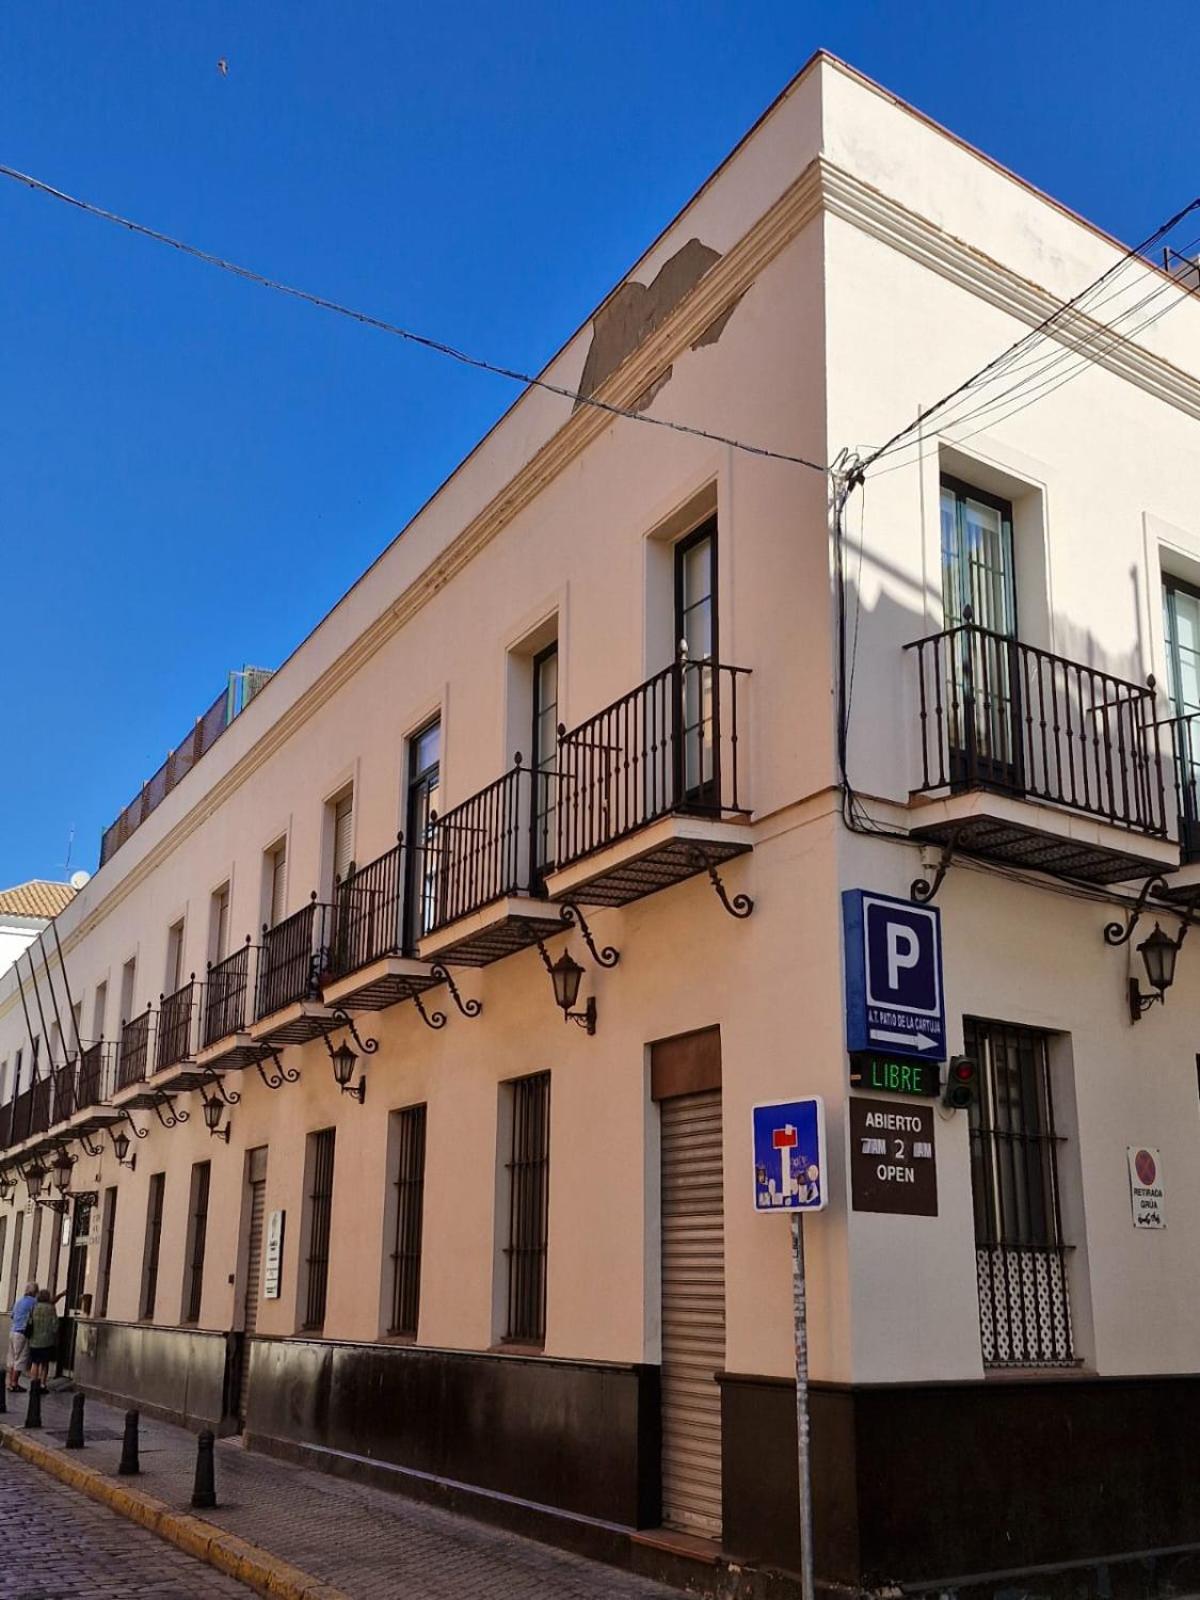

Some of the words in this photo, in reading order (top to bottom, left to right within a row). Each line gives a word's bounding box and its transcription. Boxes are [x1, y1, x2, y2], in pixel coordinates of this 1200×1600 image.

[886, 921, 920, 990] P
[880, 1011, 897, 1027] PATIO
[897, 1014, 906, 1028] DE
[906, 1016, 914, 1029] LA
[914, 1017, 941, 1033] CARTUJA
[872, 1061, 923, 1091] LIBRE
[865, 1112, 922, 1133] ABIERTO
[894, 1139, 905, 1159] 2
[876, 1164, 915, 1183] OPEN
[1133, 1187, 1163, 1198] RETIRADA
